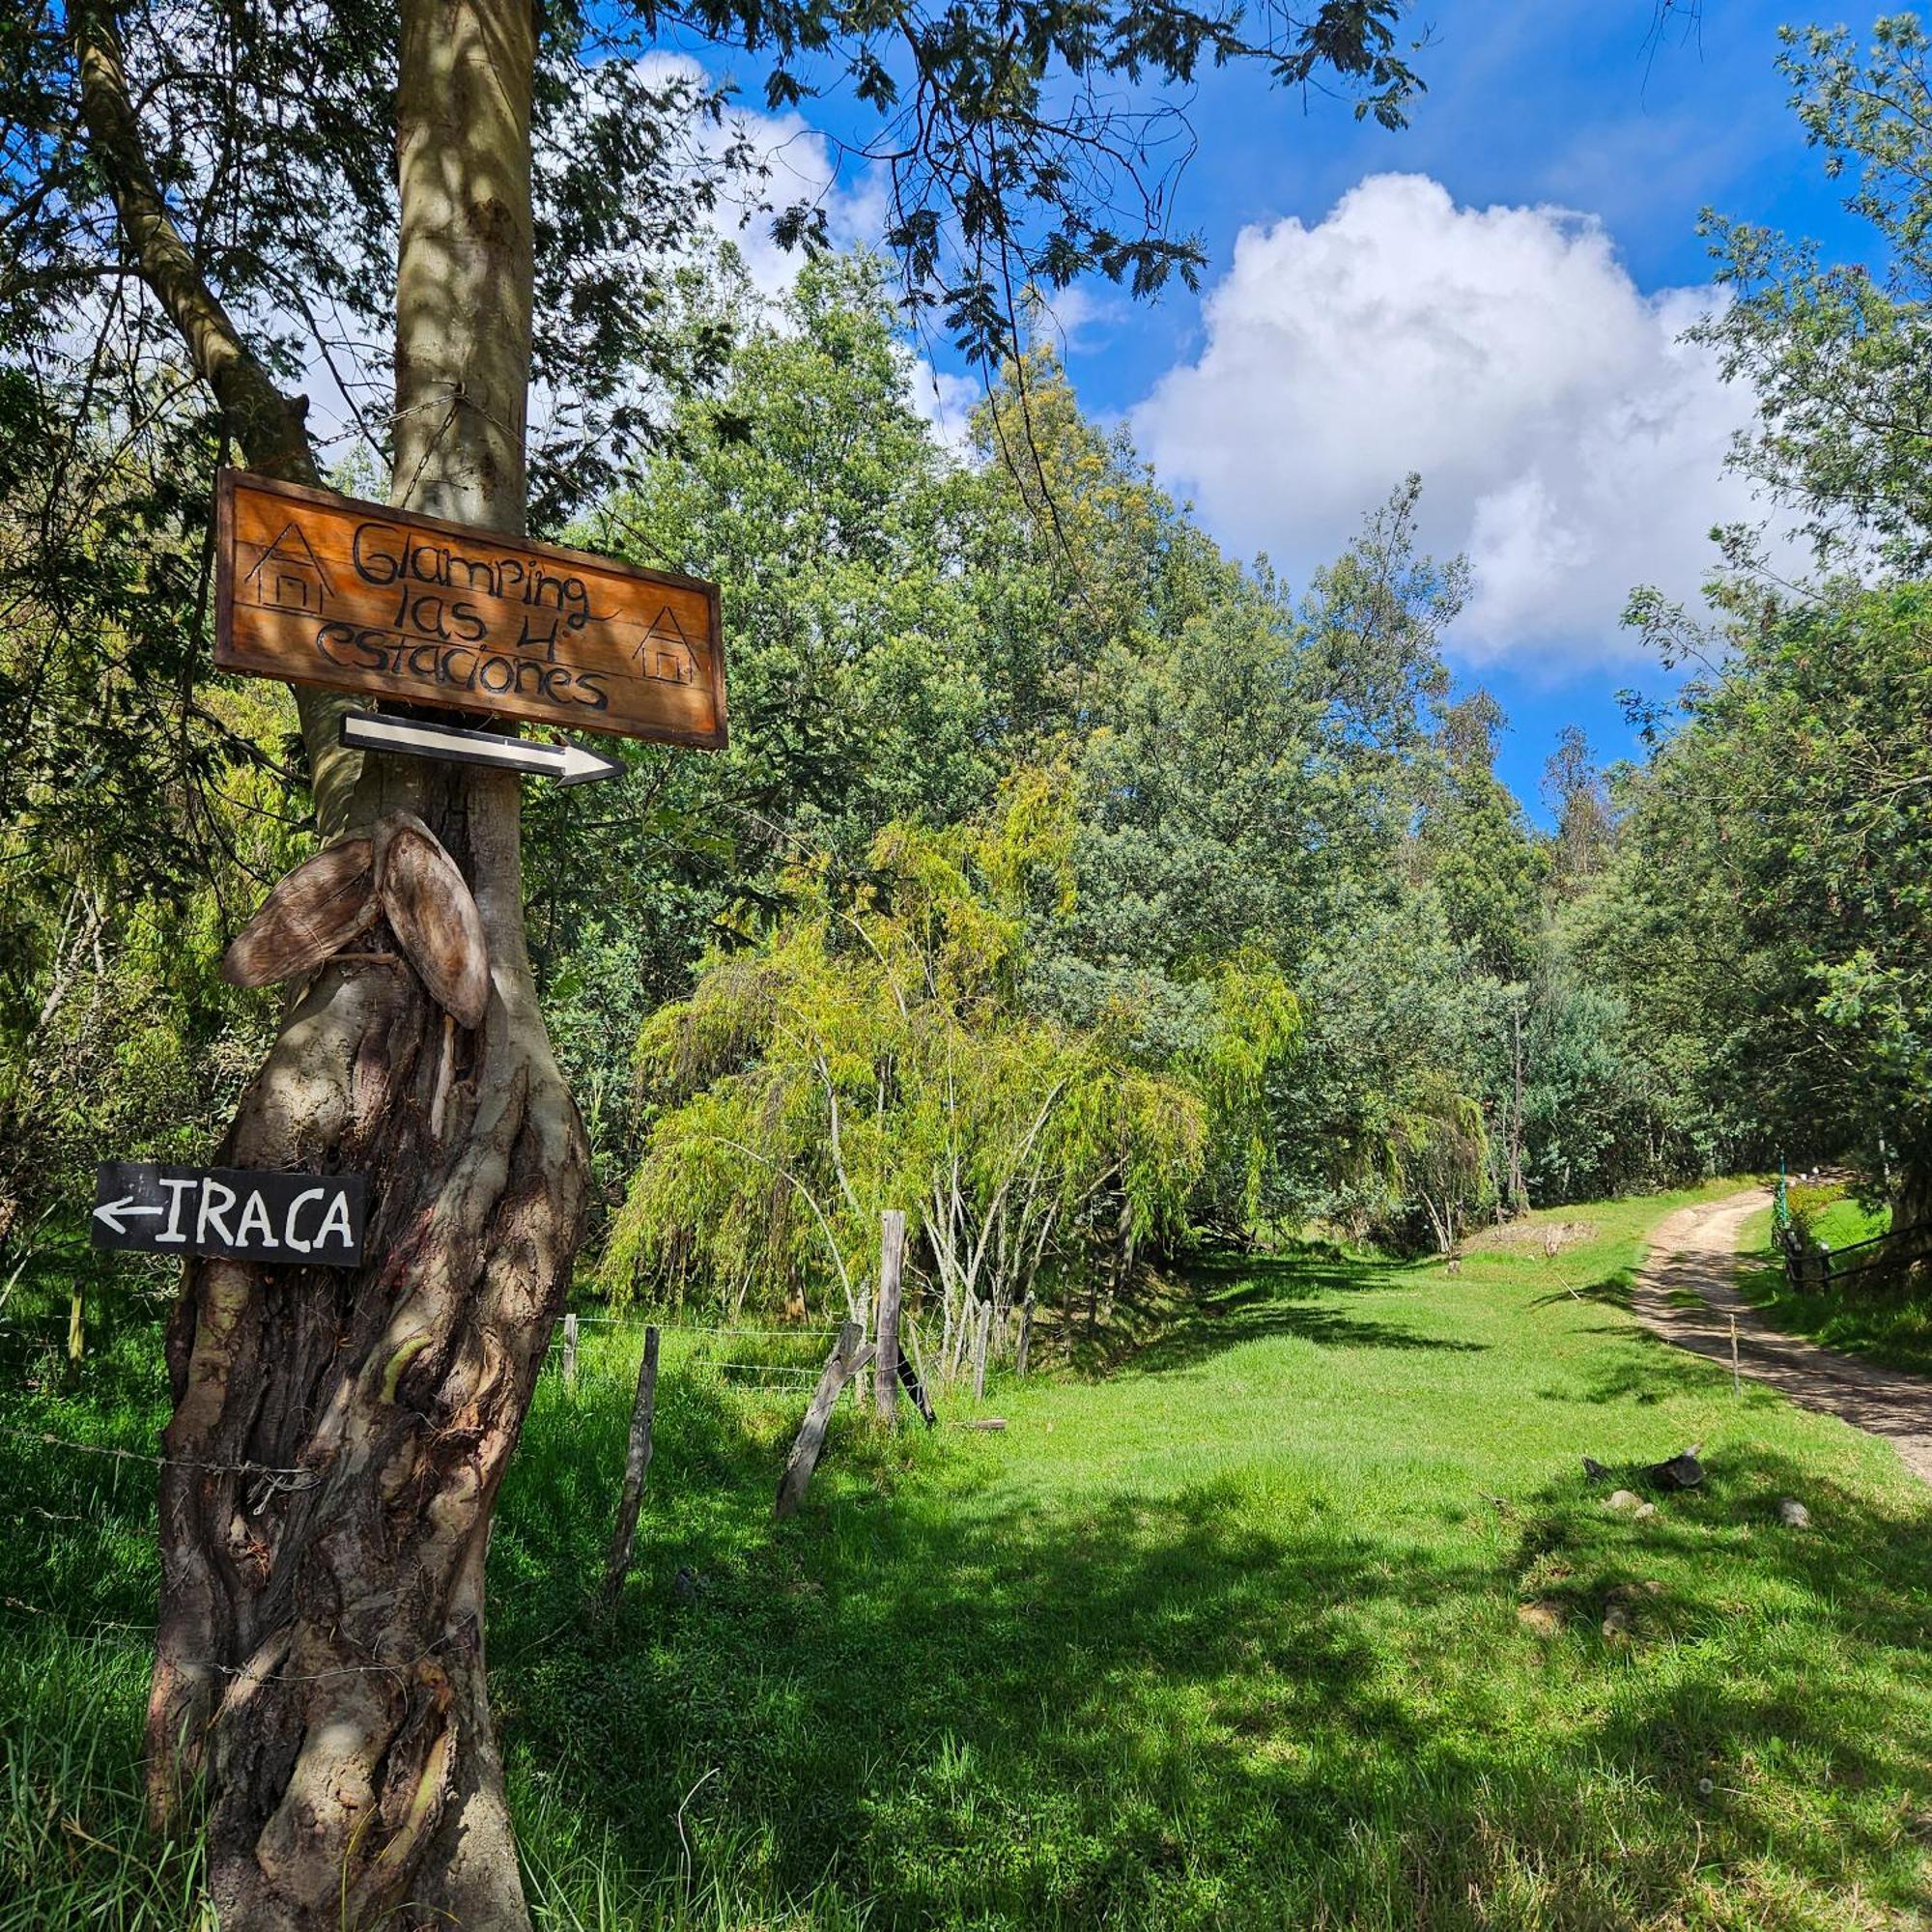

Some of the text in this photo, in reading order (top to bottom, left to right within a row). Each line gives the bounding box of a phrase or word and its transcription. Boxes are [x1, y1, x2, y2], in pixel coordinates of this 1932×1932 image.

[353, 523, 623, 629] Glamping
[318, 621, 609, 711] estaciones
[395, 585, 557, 663] las 4
[155, 1178, 354, 1253] IRACA
